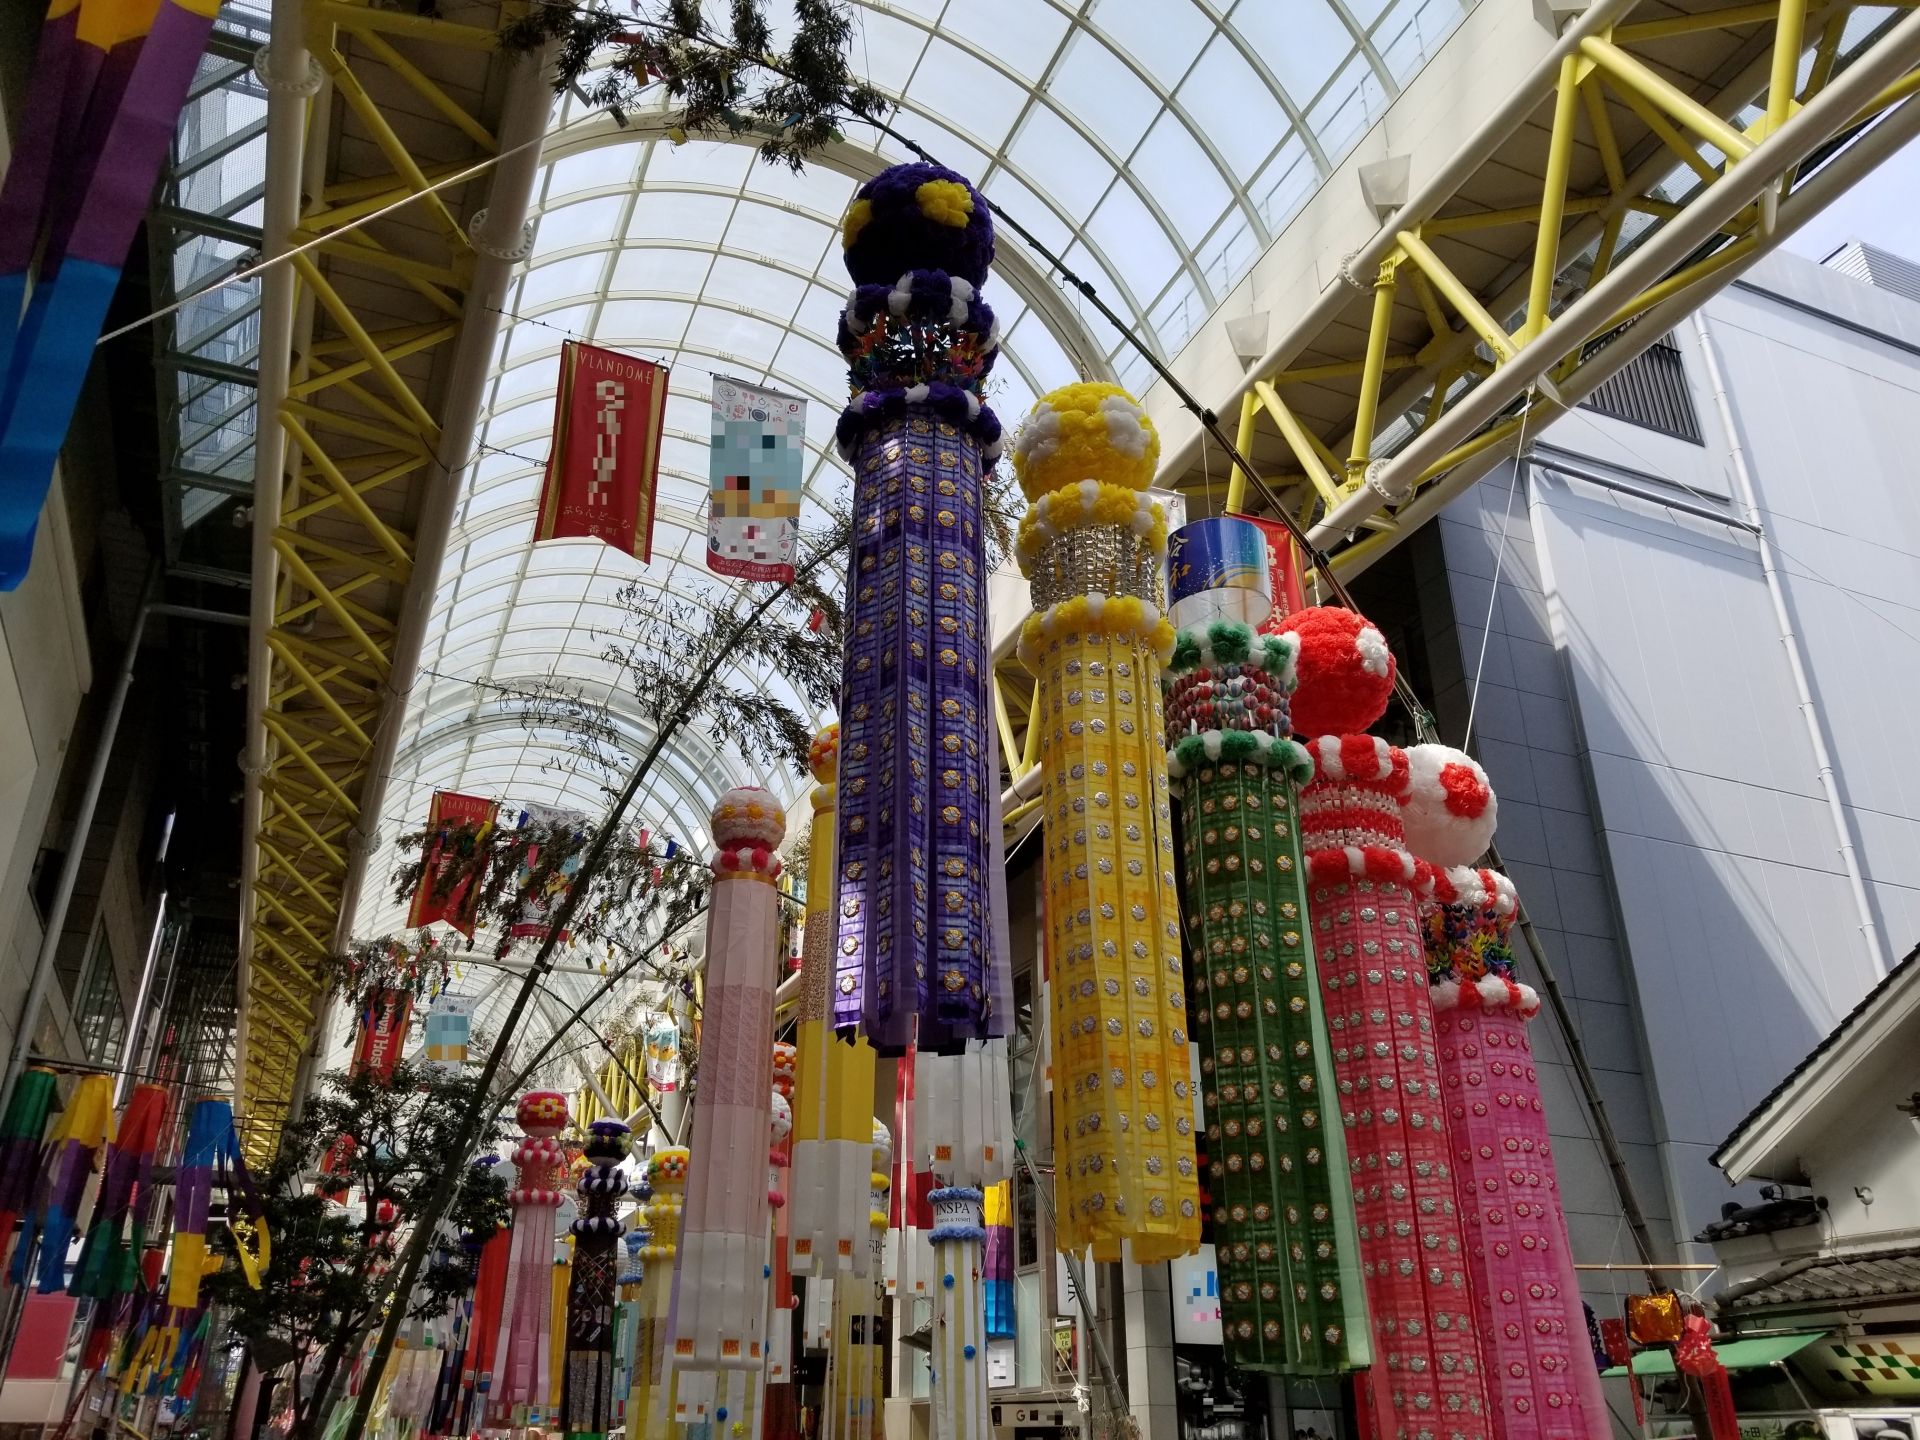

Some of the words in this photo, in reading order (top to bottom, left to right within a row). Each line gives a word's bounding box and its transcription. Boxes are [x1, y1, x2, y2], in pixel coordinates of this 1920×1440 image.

[579, 351, 653, 385] VLANDOME
[370, 1038, 390, 1069] Host
[936, 1201, 970, 1216] INSPA
